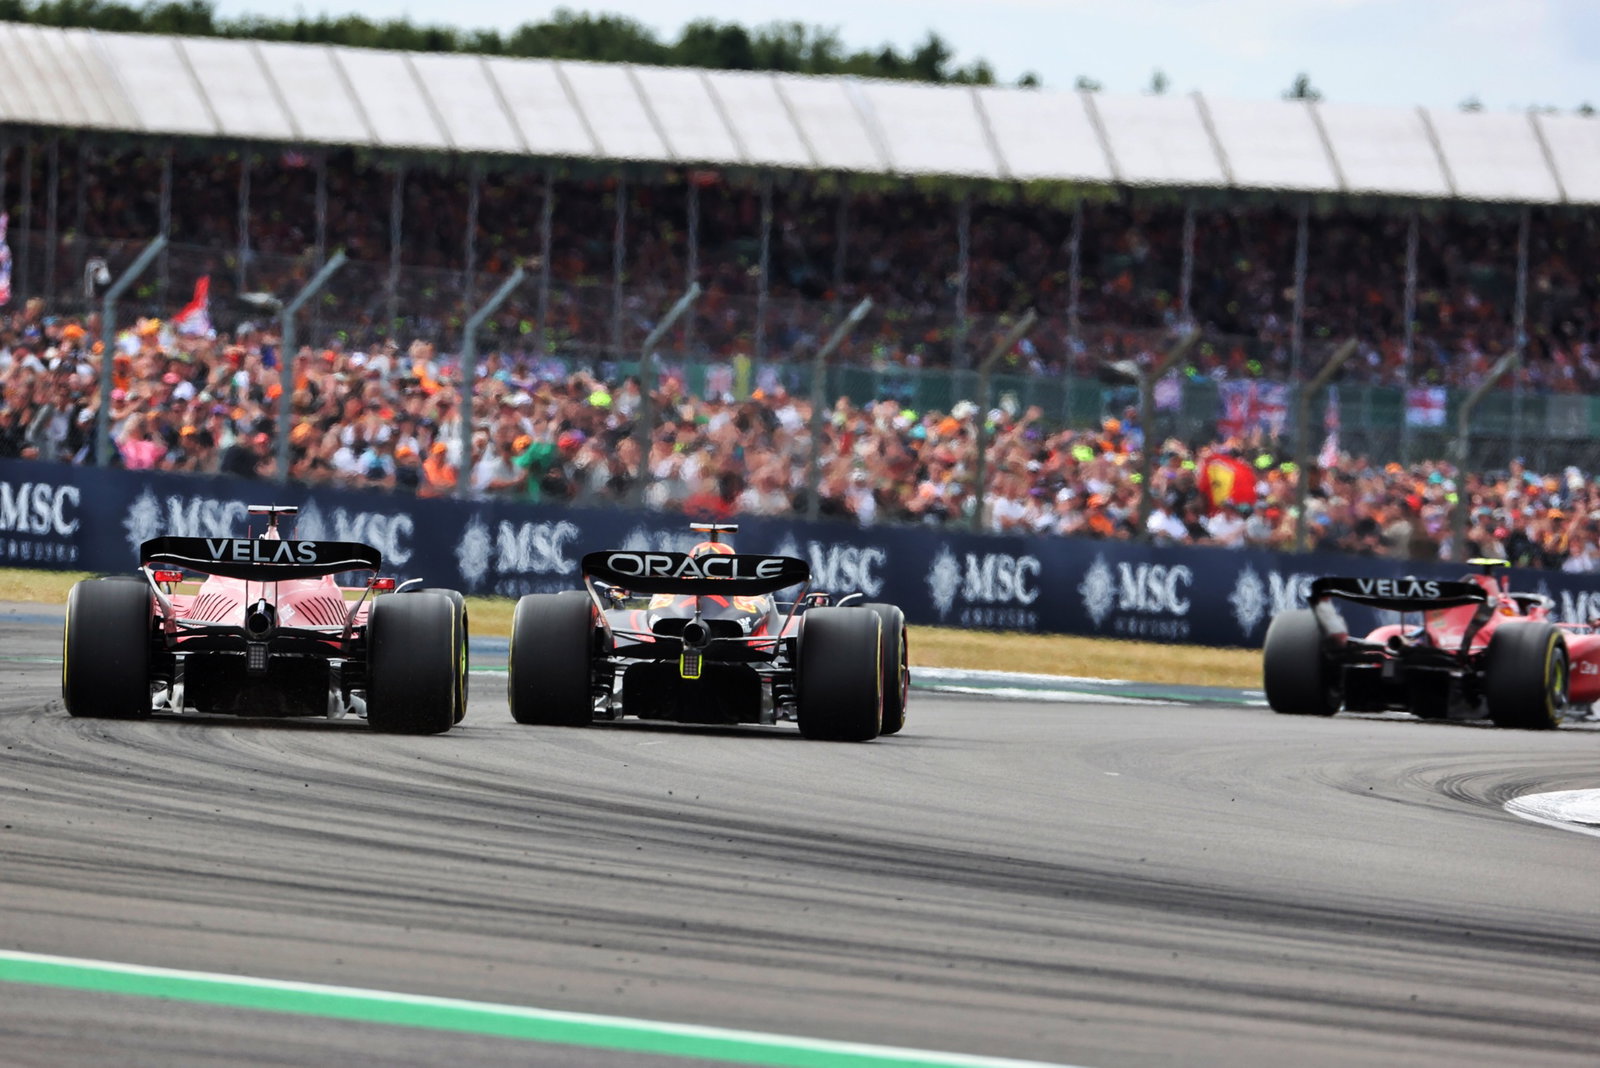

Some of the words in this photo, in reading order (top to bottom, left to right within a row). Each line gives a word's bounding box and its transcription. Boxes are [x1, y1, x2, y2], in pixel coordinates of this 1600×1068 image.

[0, 482, 80, 535] MSC
[205, 538, 317, 563] VELAS
[496, 520, 579, 574] MSC
[606, 553, 785, 580] ORACLE
[807, 541, 887, 597] MSC
[962, 553, 1041, 604] MSC
[1116, 561, 1193, 616] MSC
[1356, 578, 1441, 598] VELAS
